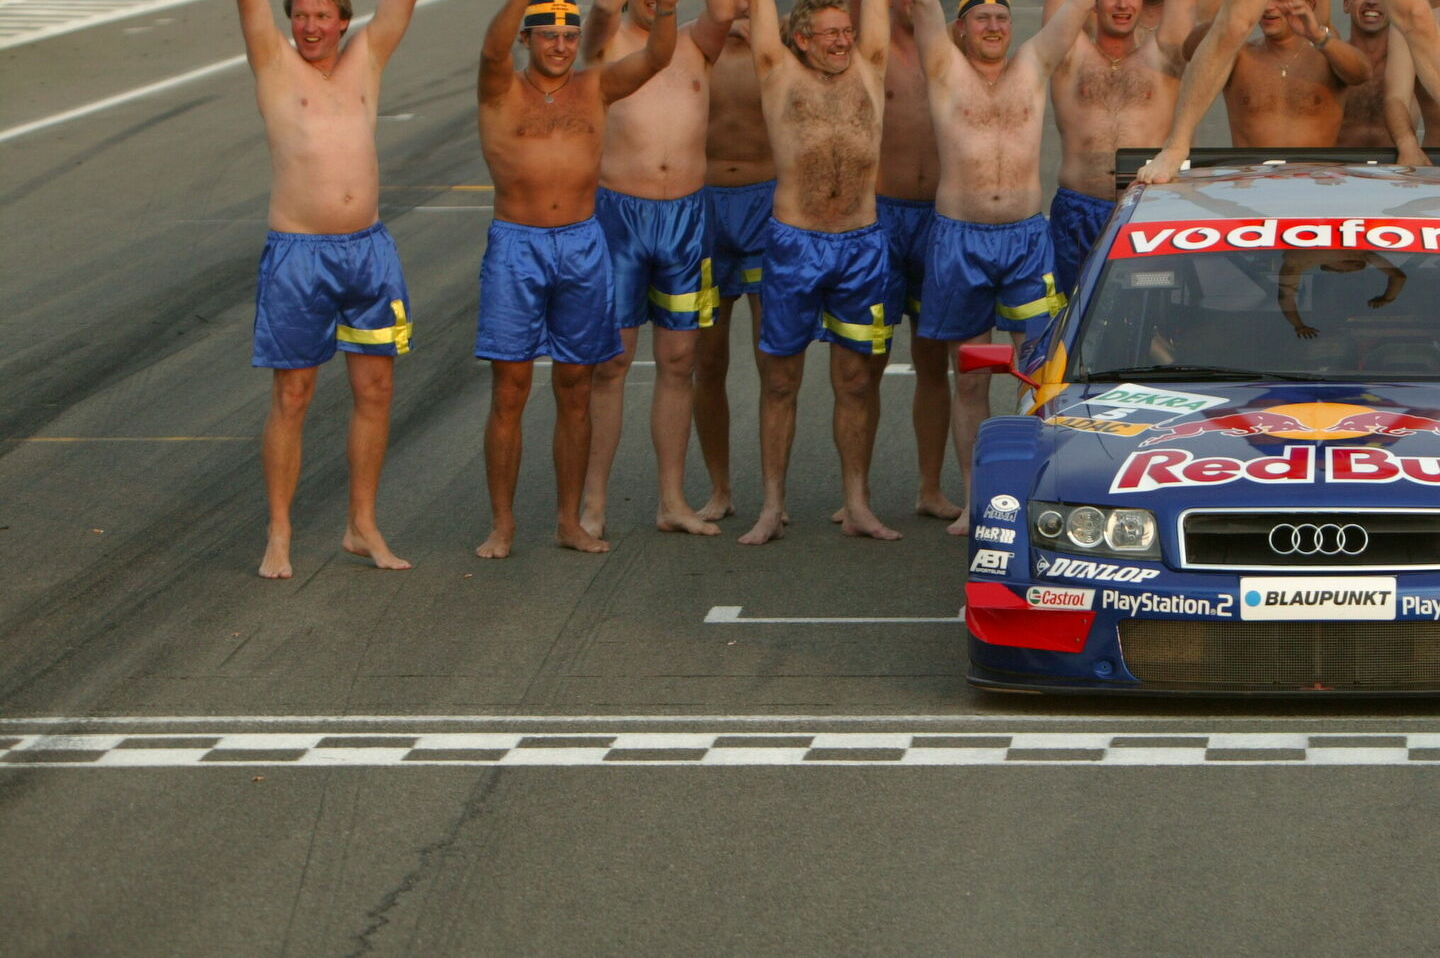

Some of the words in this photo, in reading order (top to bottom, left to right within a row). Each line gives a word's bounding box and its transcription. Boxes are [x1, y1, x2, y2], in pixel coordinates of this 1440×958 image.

[1097, 390, 1208, 411] DEKRA
[1061, 418, 1132, 433] ADAC
[1110, 446, 1315, 493] Red
[970, 549, 1009, 571] ABT
[1048, 557, 1160, 583] DUNLOP
[1041, 590, 1085, 606] Castrol
[1264, 590, 1392, 606] BLAUPUNKT
